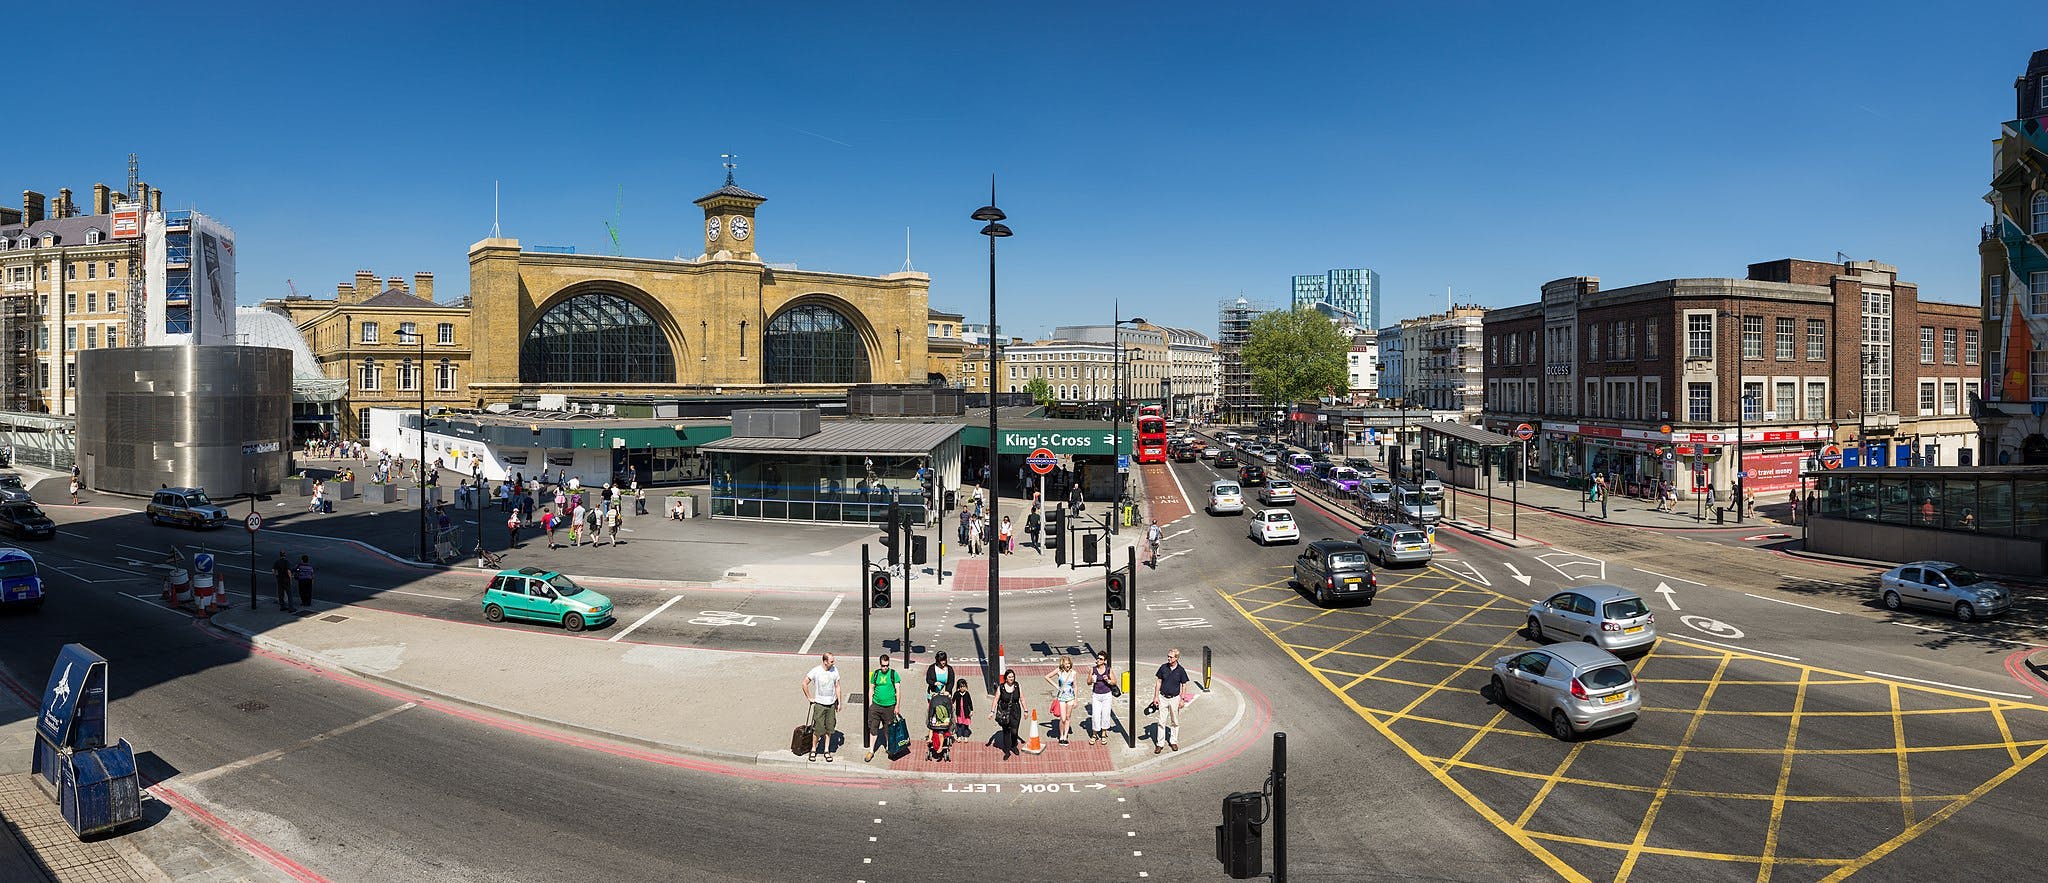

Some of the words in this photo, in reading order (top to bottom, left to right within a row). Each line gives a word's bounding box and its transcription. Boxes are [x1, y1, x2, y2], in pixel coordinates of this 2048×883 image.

[1546, 365, 1569, 375] access
[1005, 433, 1049, 449] King's
[1051, 433, 1091, 447] Cross
[1758, 468, 1774, 477] travel
[1775, 468, 1793, 476] money
[249, 516, 260, 526] 20
[942, 783, 1001, 793] LEFT
[1020, 783, 1081, 793] LOOK
